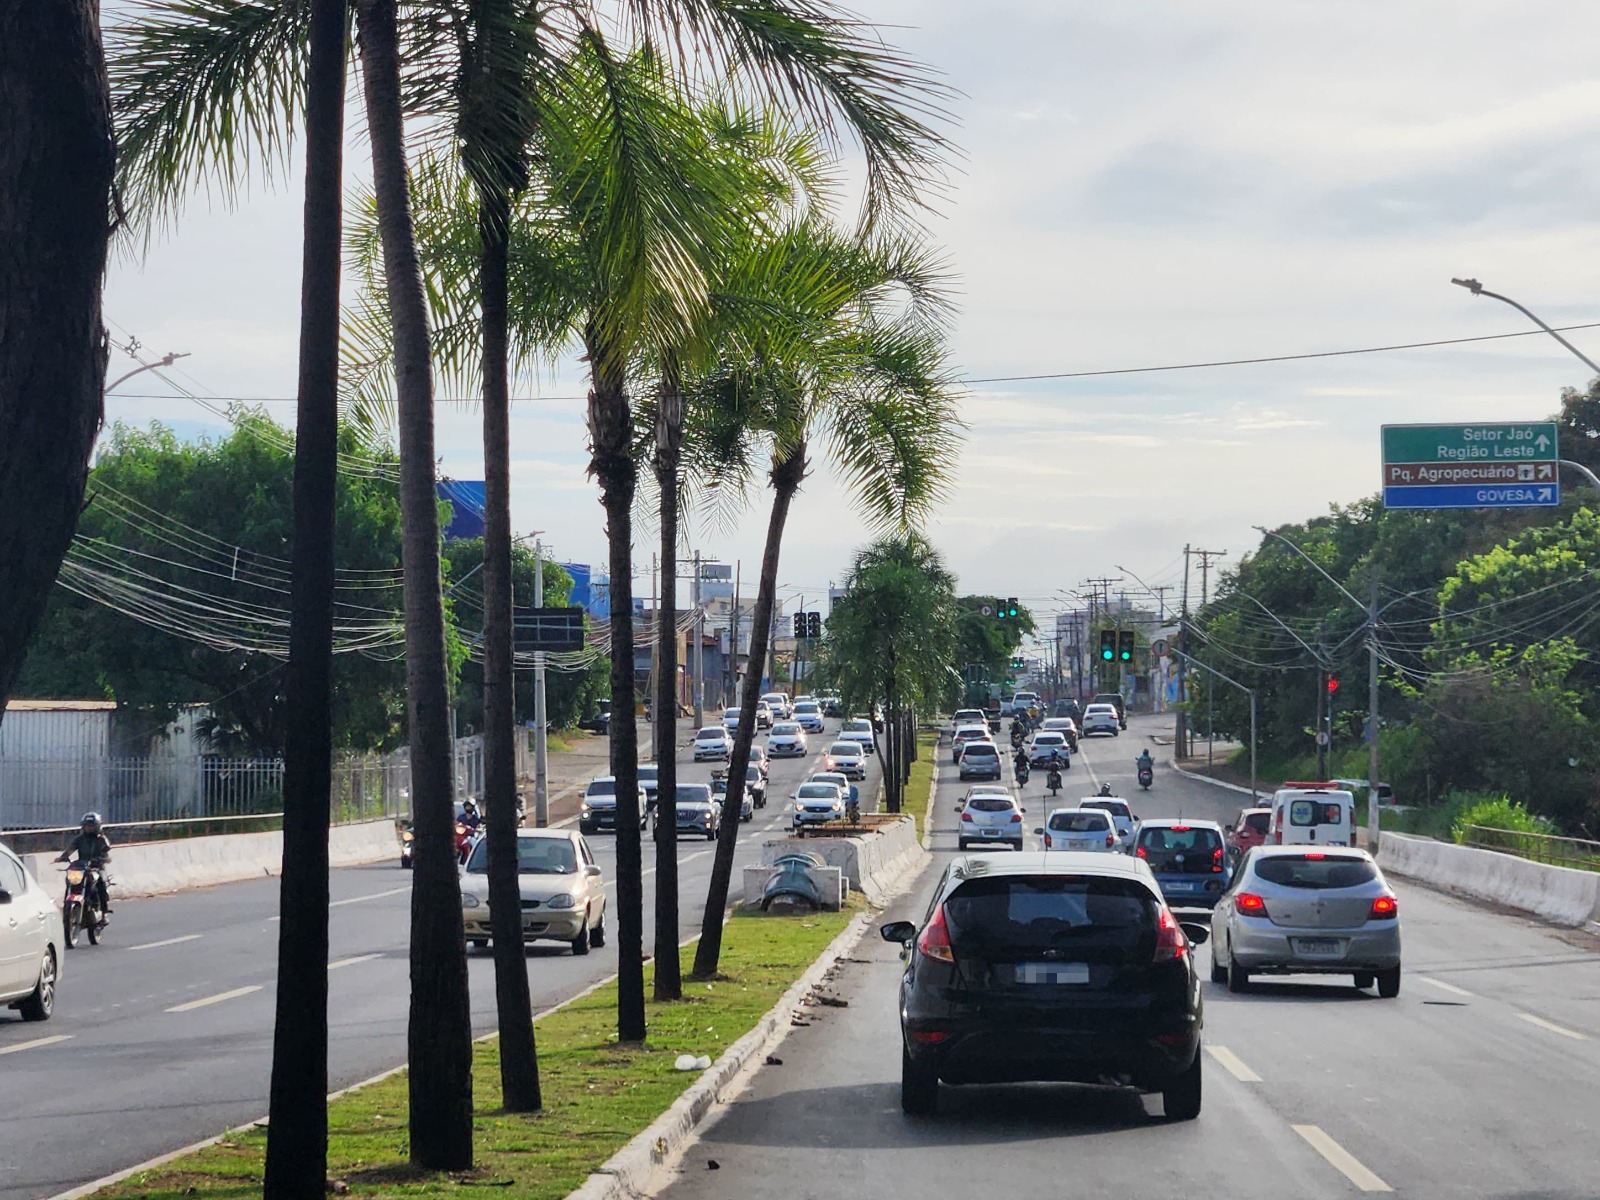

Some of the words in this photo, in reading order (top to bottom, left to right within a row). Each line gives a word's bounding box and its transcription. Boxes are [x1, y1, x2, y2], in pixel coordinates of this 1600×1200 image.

[1463, 428, 1502, 441] Setor
[1507, 427, 1534, 440] Jaó
[1437, 445, 1489, 460] Região
[1494, 444, 1535, 457] Leste
[1391, 467, 1414, 482] Pq.
[1418, 466, 1516, 481] Agropecuário
[1476, 490, 1534, 502] GOVESA
